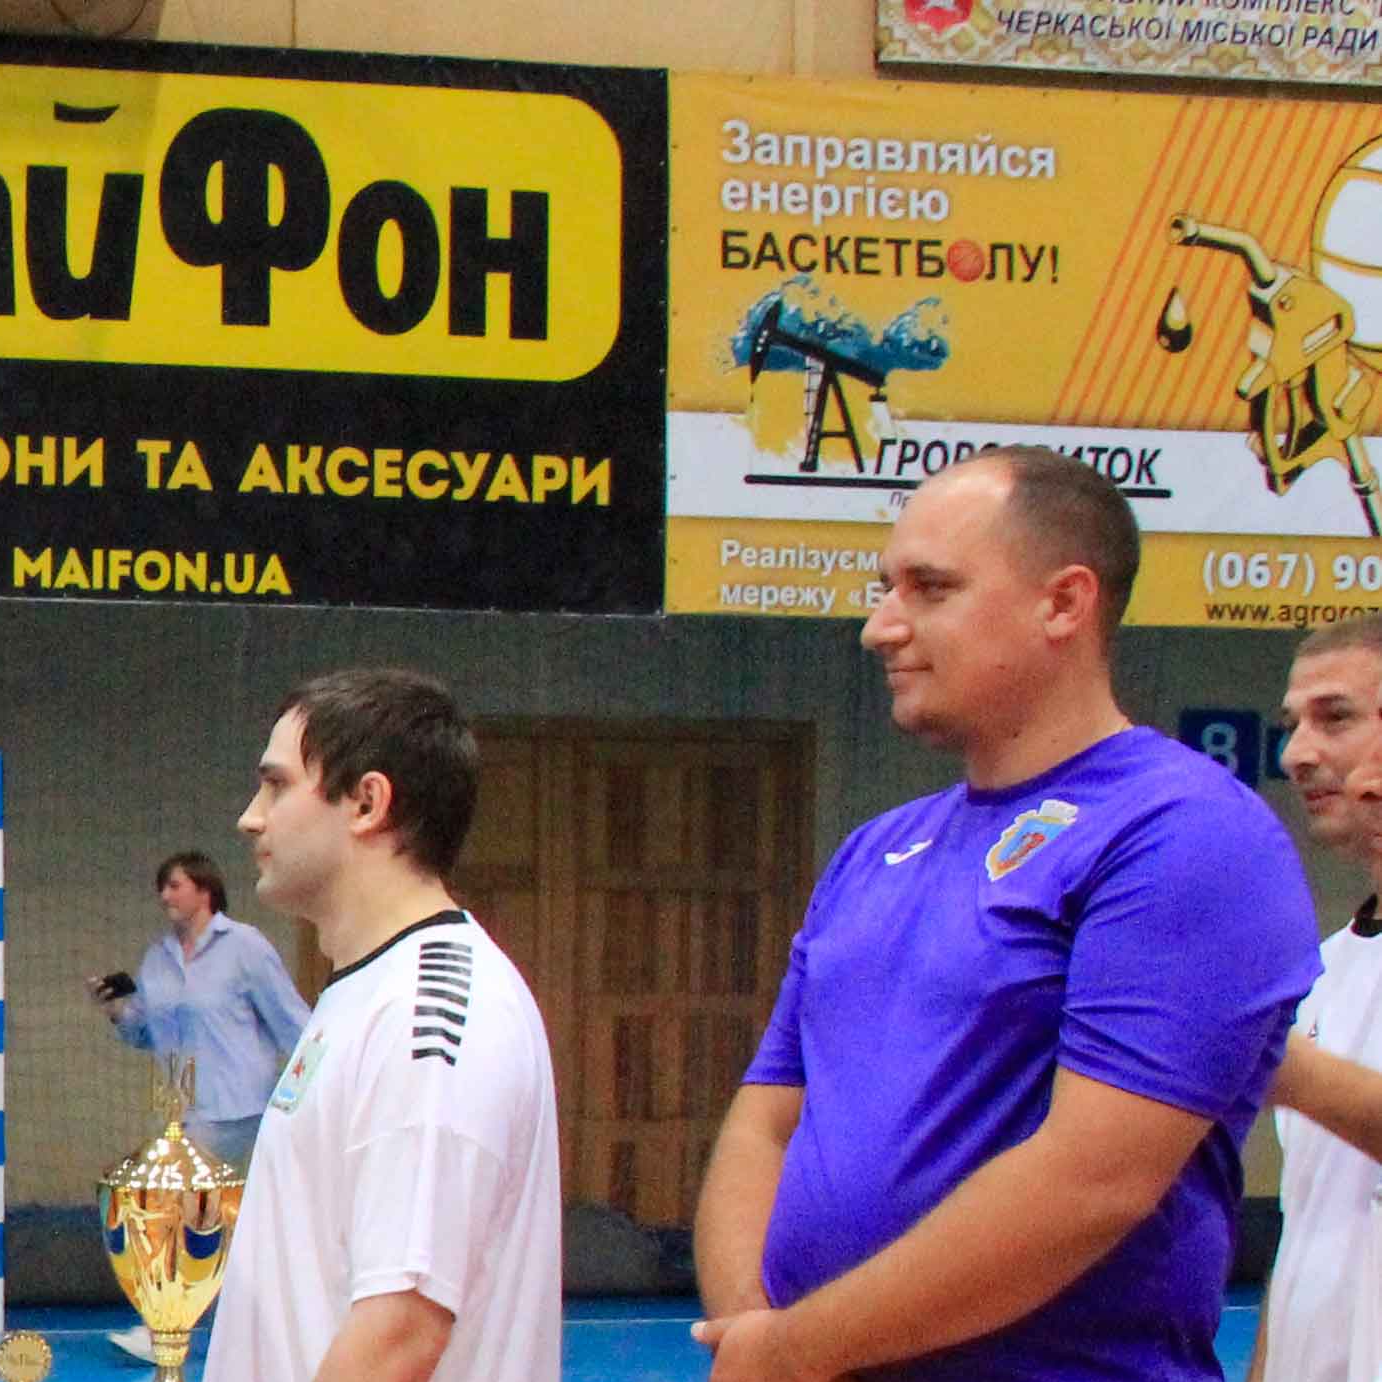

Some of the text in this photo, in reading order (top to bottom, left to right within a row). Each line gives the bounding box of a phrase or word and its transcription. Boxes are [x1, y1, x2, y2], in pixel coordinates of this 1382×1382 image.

[1302, 25, 1380, 56] РАДИ
[721, 119, 1055, 178] Заправляйся
[720, 176, 949, 226] енергією
[137, 438, 212, 493] ТА
[239, 443, 611, 506] АКСЕСУАРИ
[12, 547, 292, 596] MAIFON.UA
[1203, 551, 1316, 597] (067)
[720, 583, 836, 614] мережу
[1208, 721, 1239, 782] 8
